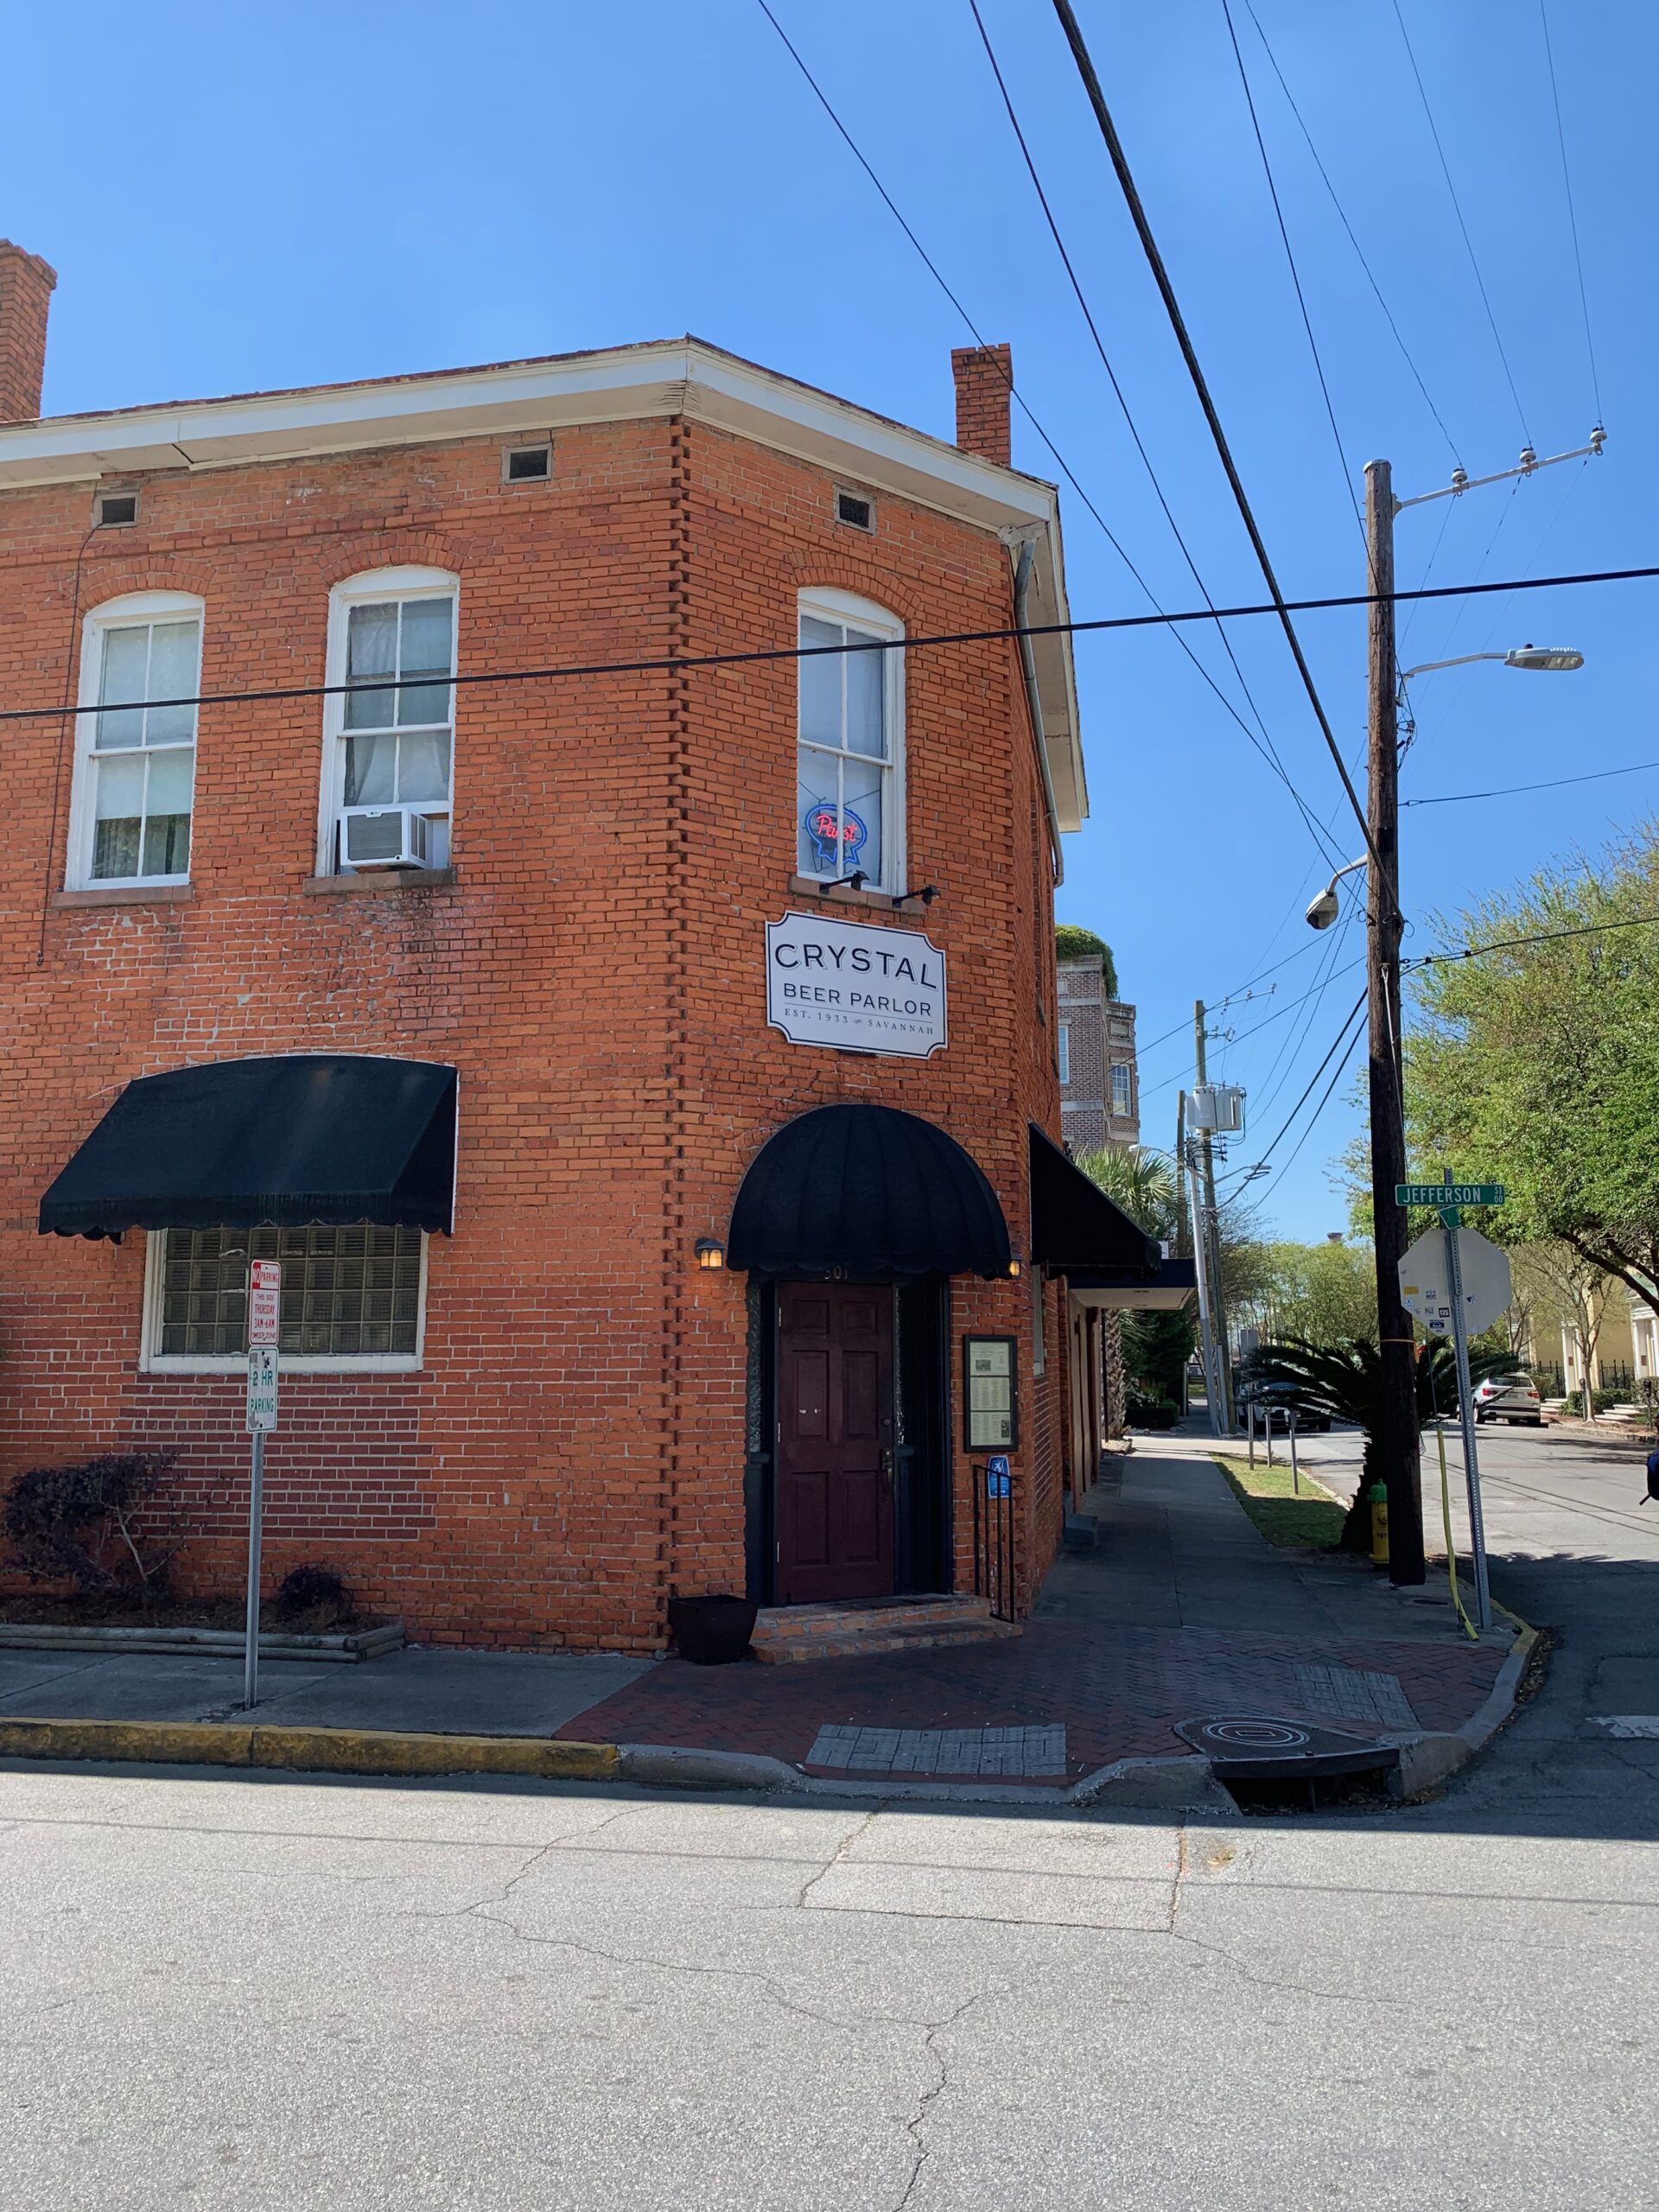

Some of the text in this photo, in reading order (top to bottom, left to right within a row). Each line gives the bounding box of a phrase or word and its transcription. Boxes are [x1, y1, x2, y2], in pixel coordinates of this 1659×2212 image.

[817, 814, 857, 842] Past
[775, 944, 938, 990] CRYSTAL
[784, 982, 931, 1017] BEER PARLOR
[785, 1007, 934, 1035] EST. 1933 SAVANNAH
[1403, 1186, 1503, 1204] JEFFERSON ST
[252, 1268, 278, 1284] NO PARKING
[254, 1303, 276, 1314] THURSDAY
[252, 1370, 273, 1387] 2 HR
[250, 1398, 275, 1414] PARKING
